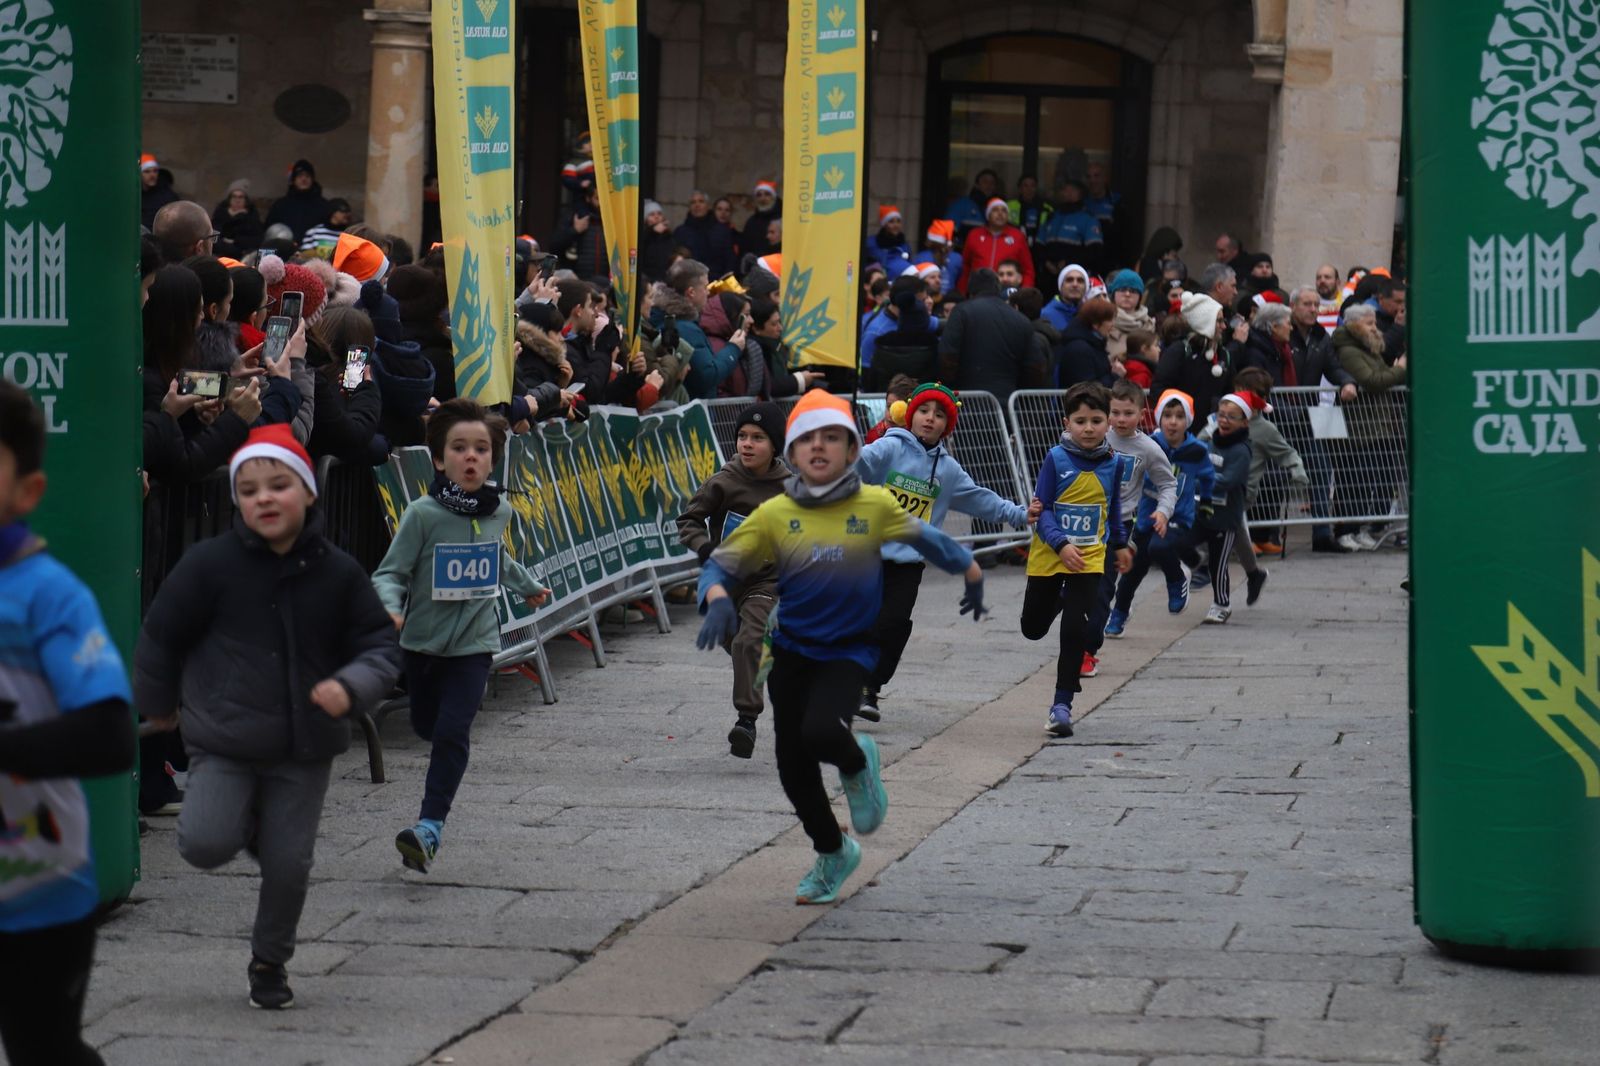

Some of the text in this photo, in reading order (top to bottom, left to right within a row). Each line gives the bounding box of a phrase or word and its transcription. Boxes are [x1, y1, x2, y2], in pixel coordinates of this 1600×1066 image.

[0, 351, 68, 390] ON
[1472, 413, 1587, 457] CAJA
[1061, 513, 1091, 532] 078
[447, 557, 490, 581] 040
